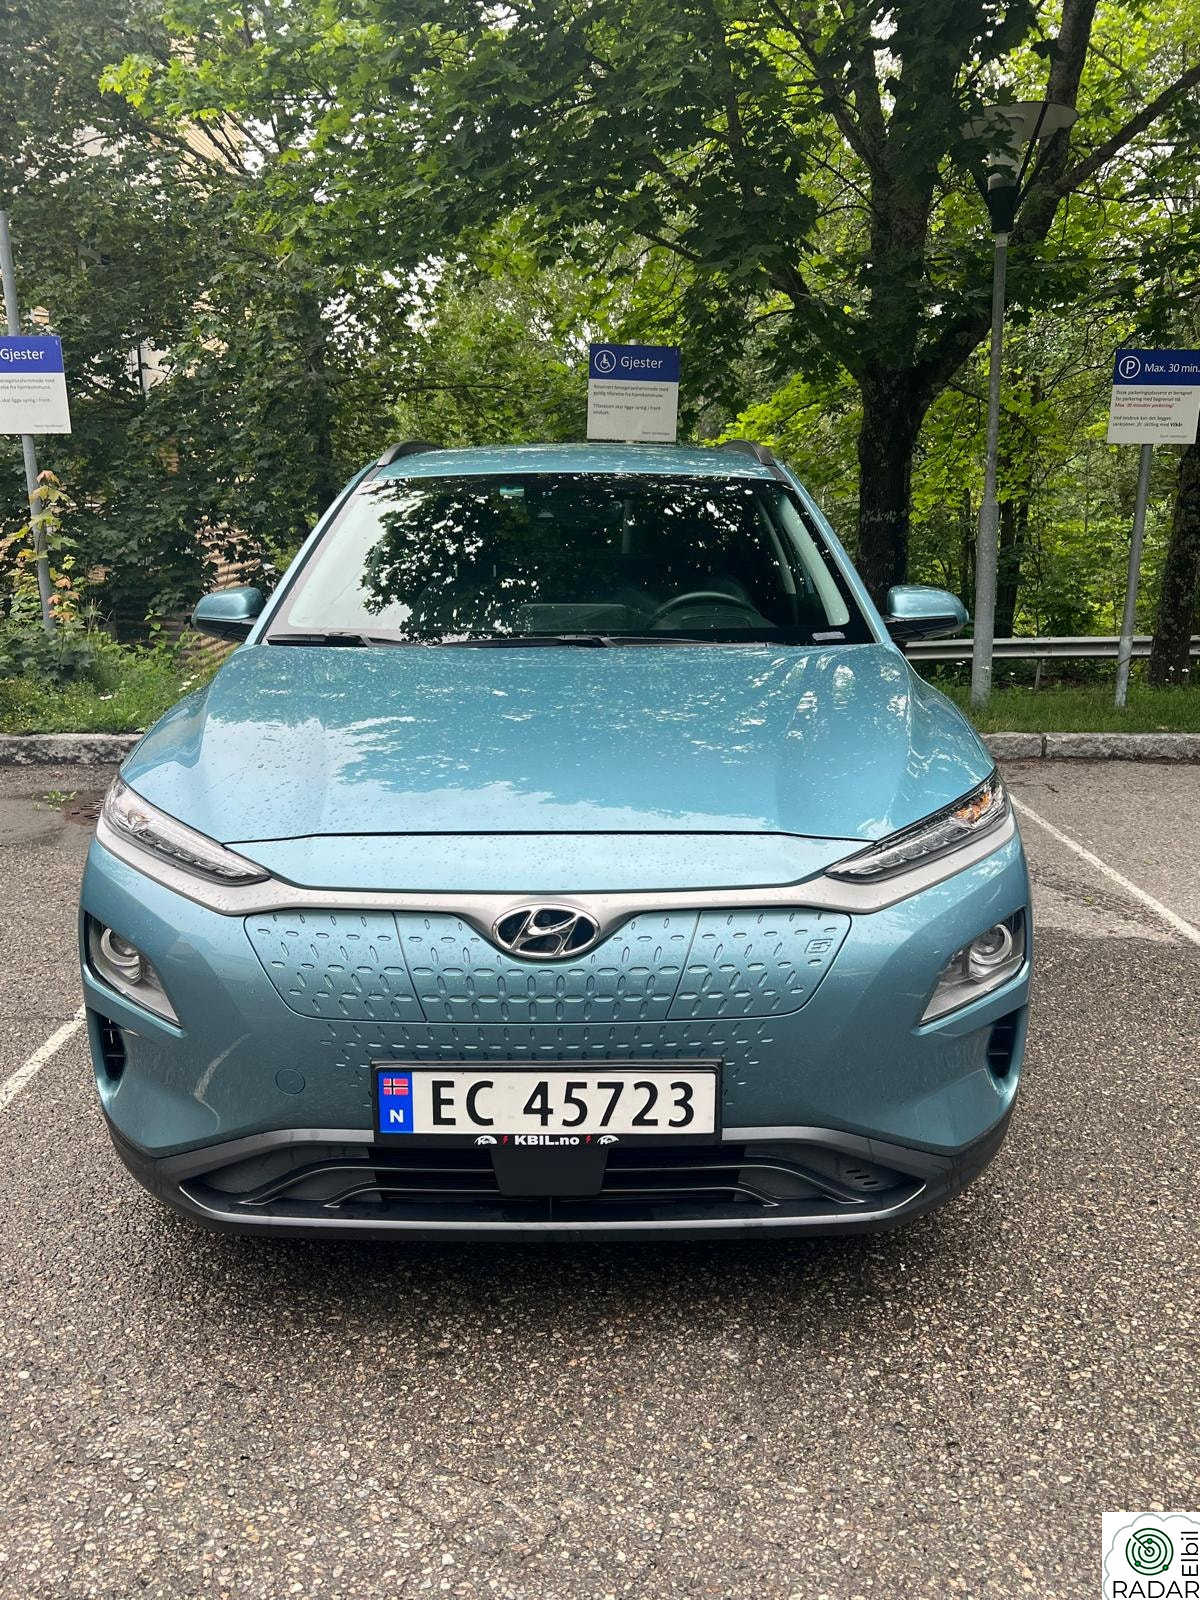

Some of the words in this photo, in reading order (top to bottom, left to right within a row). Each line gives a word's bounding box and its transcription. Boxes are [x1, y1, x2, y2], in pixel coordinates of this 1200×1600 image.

[0, 348, 45, 362] Gjester
[620, 356, 663, 370] Gjester
[1126, 360, 1136, 374] P
[1144, 364, 1166, 372] Max.
[1168, 364, 1180, 372] 30
[432, 1080, 494, 1126] EC
[522, 1080, 694, 1127] 45723
[390, 1110, 404, 1124] N
[514, 1135, 580, 1146] KBIL.no
